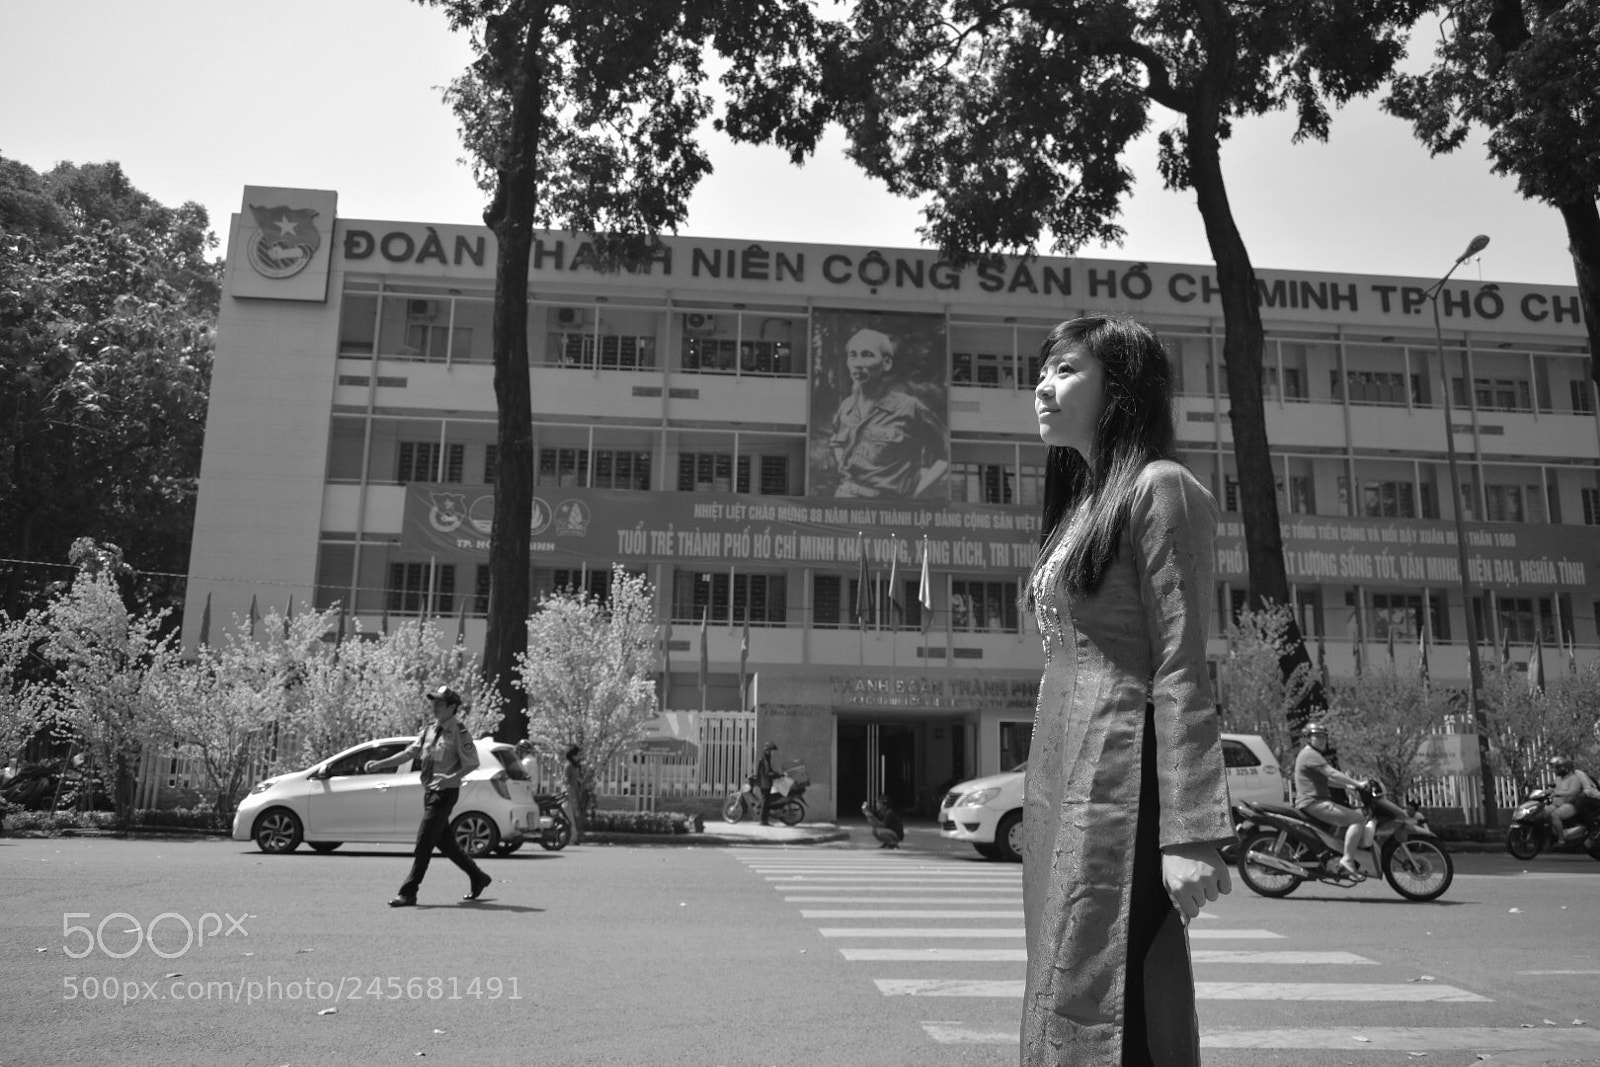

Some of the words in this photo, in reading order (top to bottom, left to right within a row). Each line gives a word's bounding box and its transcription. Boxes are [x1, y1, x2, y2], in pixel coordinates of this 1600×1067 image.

[344, 226, 485, 266] ĐOÀN
[692, 244, 804, 282] NIÊN
[822, 250, 960, 295] CỘNG
[1088, 262, 1153, 300] HỒ
[1168, 273, 1223, 303] CH
[1257, 278, 1358, 312] MINH
[1443, 284, 1504, 320] HỒ
[694, 501, 723, 522] NHIỆT
[726, 502, 746, 522] LIỆT
[617, 520, 647, 554] TUỔI
[650, 523, 674, 556] TRẺ
[677, 526, 720, 557] THÀNH
[723, 524, 751, 558] PHỐ
[775, 530, 797, 560] CHÍ
[800, 535, 834, 561] MINH
